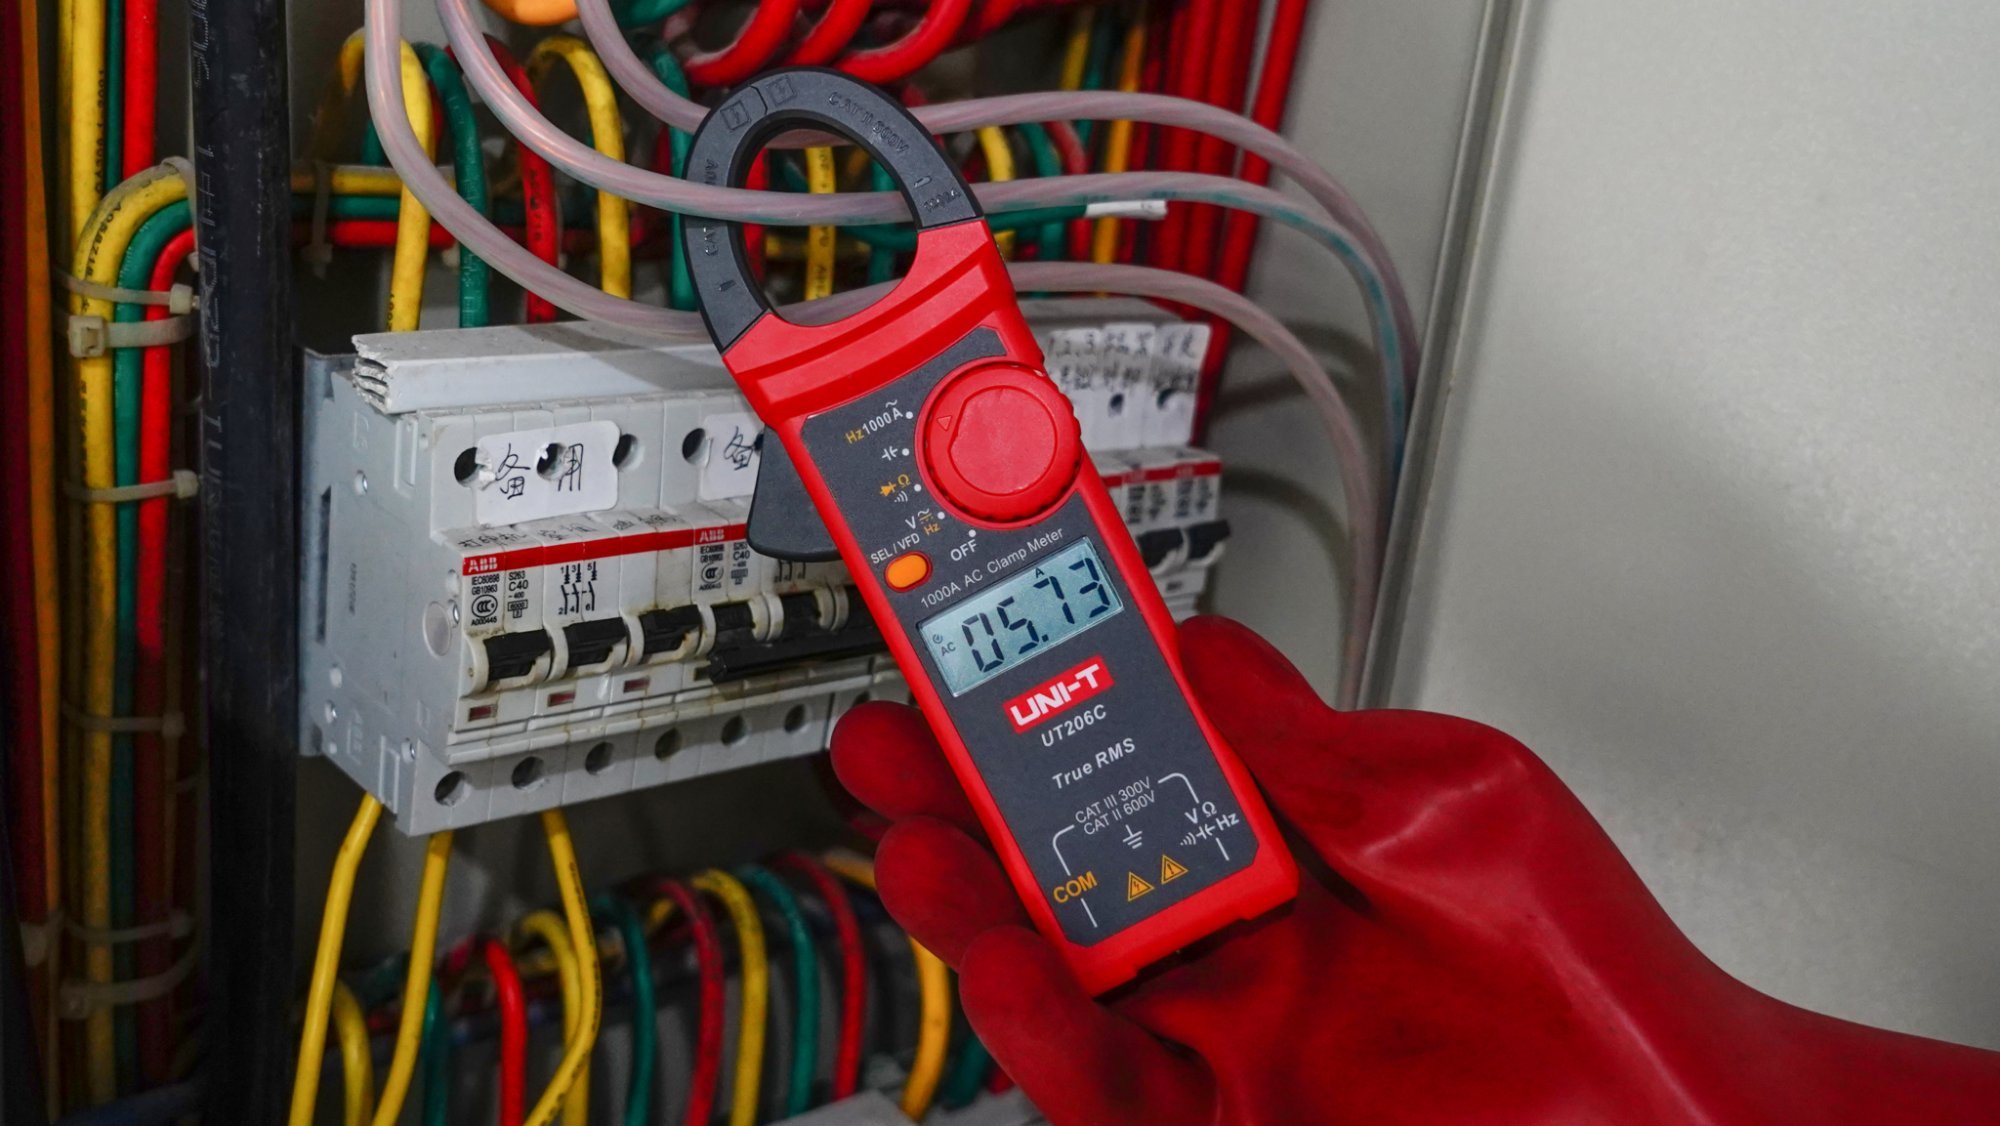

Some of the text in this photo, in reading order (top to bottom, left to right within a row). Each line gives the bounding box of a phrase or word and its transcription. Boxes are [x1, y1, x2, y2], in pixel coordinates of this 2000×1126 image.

[699, 528, 725, 542] ABB
[923, 522, 941, 536] Hz
[733, 550, 750, 561] C40
[950, 538, 978, 562] OFF
[468, 556, 498, 573] ABB
[921, 527, 1064, 609] 1000A AC Clamp Meter
[1034, 567, 1045, 578] A
[508, 580, 528, 592] C40
[961, 557, 1110, 673] 05.73
[941, 641, 957, 657] AC
[1010, 663, 1100, 727] UNI-T
[1041, 704, 1107, 747] UT206C
[1052, 737, 1136, 790] True RMS
[1075, 775, 1152, 825] CAT III 300V
[1083, 790, 1156, 836] CAT II 600V
[1184, 808, 1199, 825] V
[1215, 811, 1240, 831] Hz
[1053, 870, 1098, 904] COM
